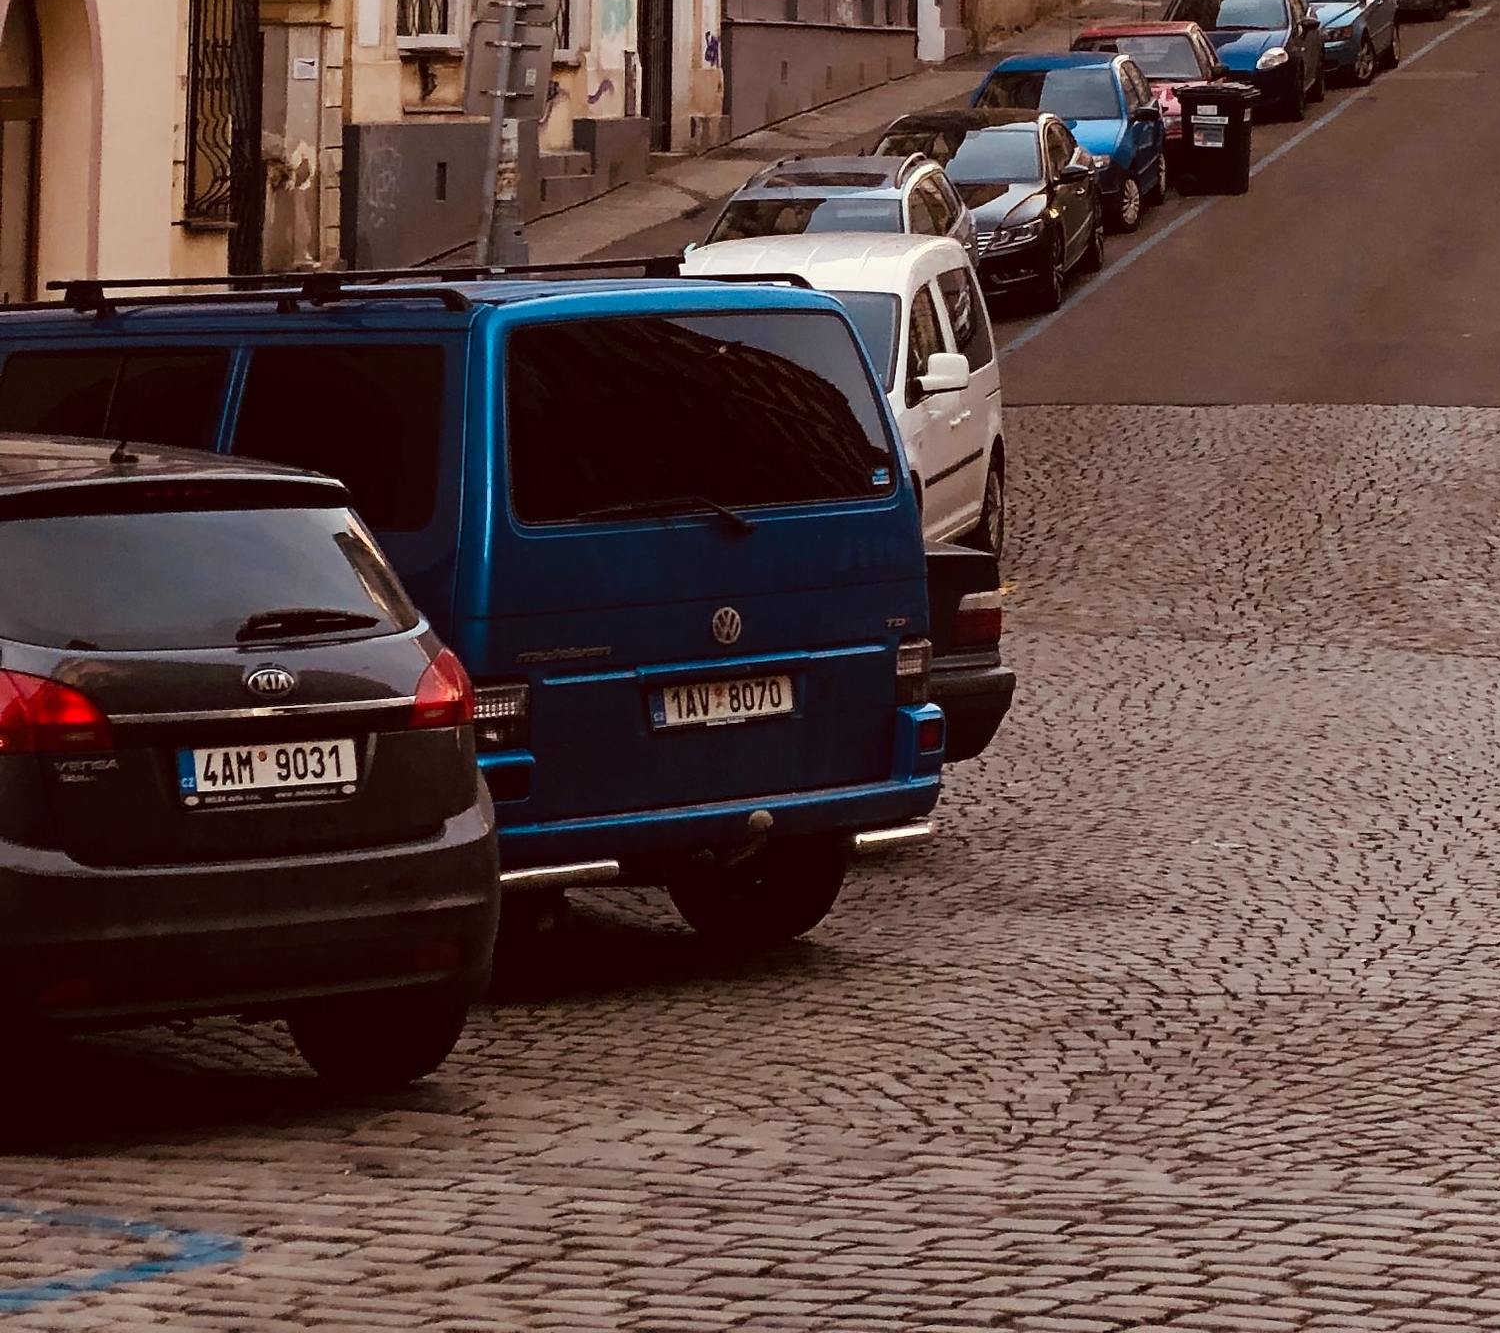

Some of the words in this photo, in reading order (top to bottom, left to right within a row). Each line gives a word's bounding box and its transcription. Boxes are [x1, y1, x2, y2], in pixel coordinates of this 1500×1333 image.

[256, 674, 290, 691] KIA
[672, 685, 710, 719] 1AV
[728, 679, 782, 713] 8070
[203, 750, 255, 787] 4AM
[275, 744, 342, 781] 9031
